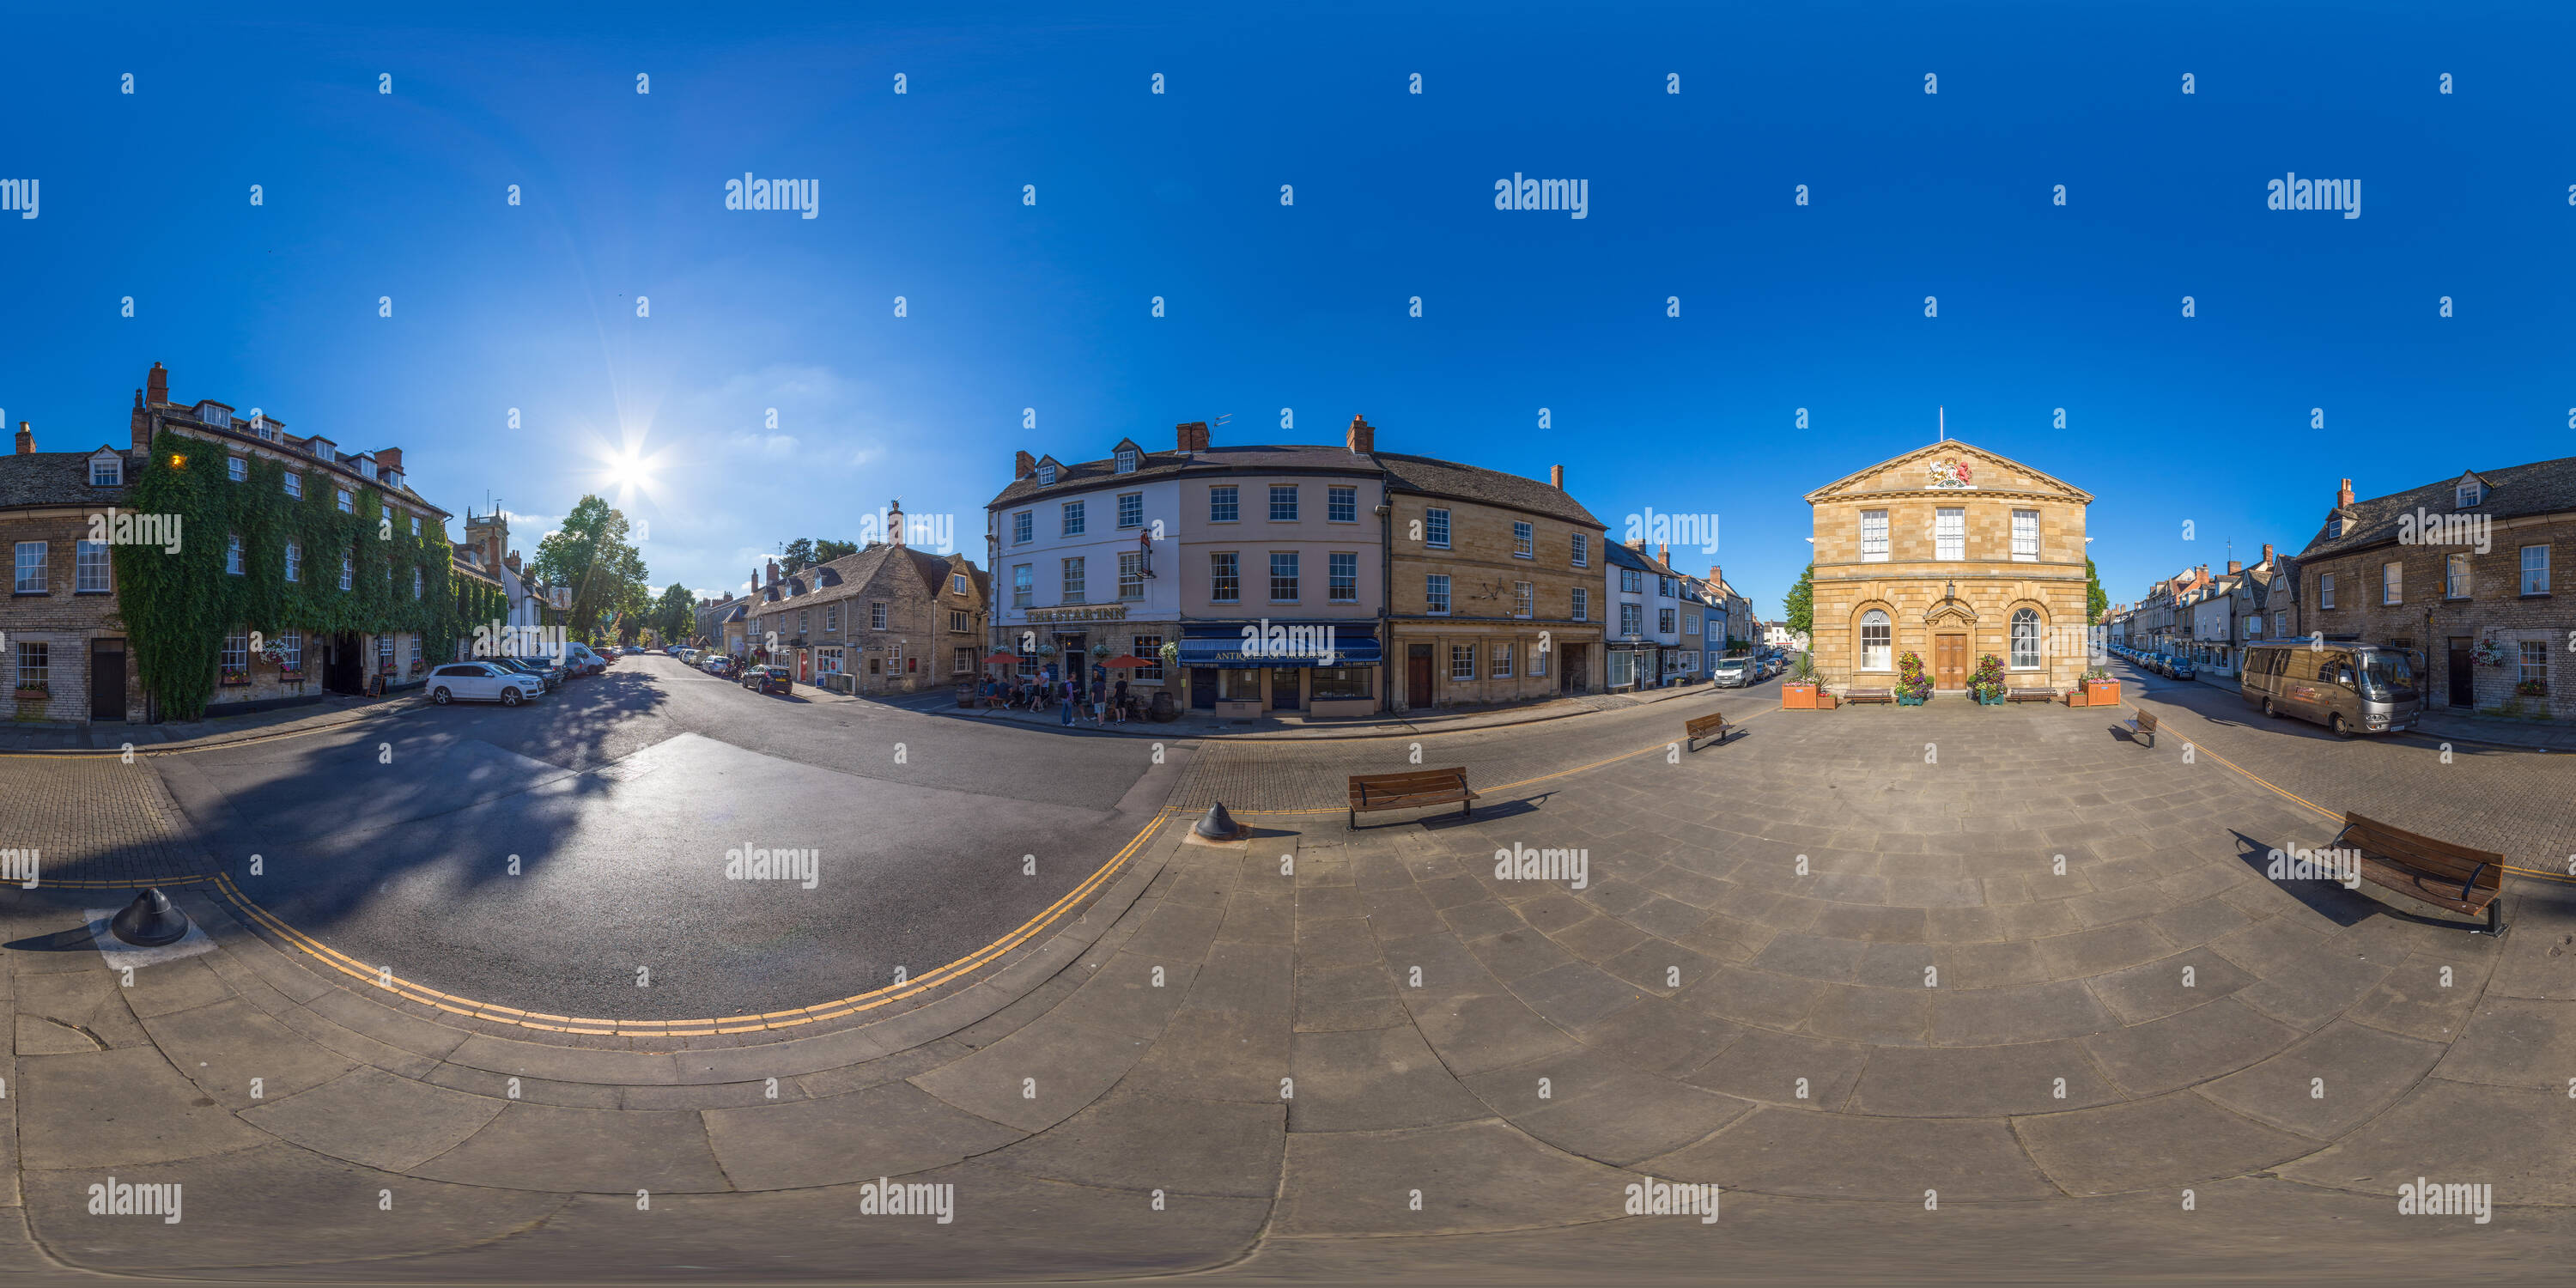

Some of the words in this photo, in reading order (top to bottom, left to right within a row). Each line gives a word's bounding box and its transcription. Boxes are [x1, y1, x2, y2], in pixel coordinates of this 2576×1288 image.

[1025, 611, 1053, 623] THE
[1056, 609, 1093, 621] STAR
[1096, 607, 1128, 619] INN
[1215, 652, 1264, 661] ANTIQUES
[1285, 651, 1346, 659] WOODSTOCK
